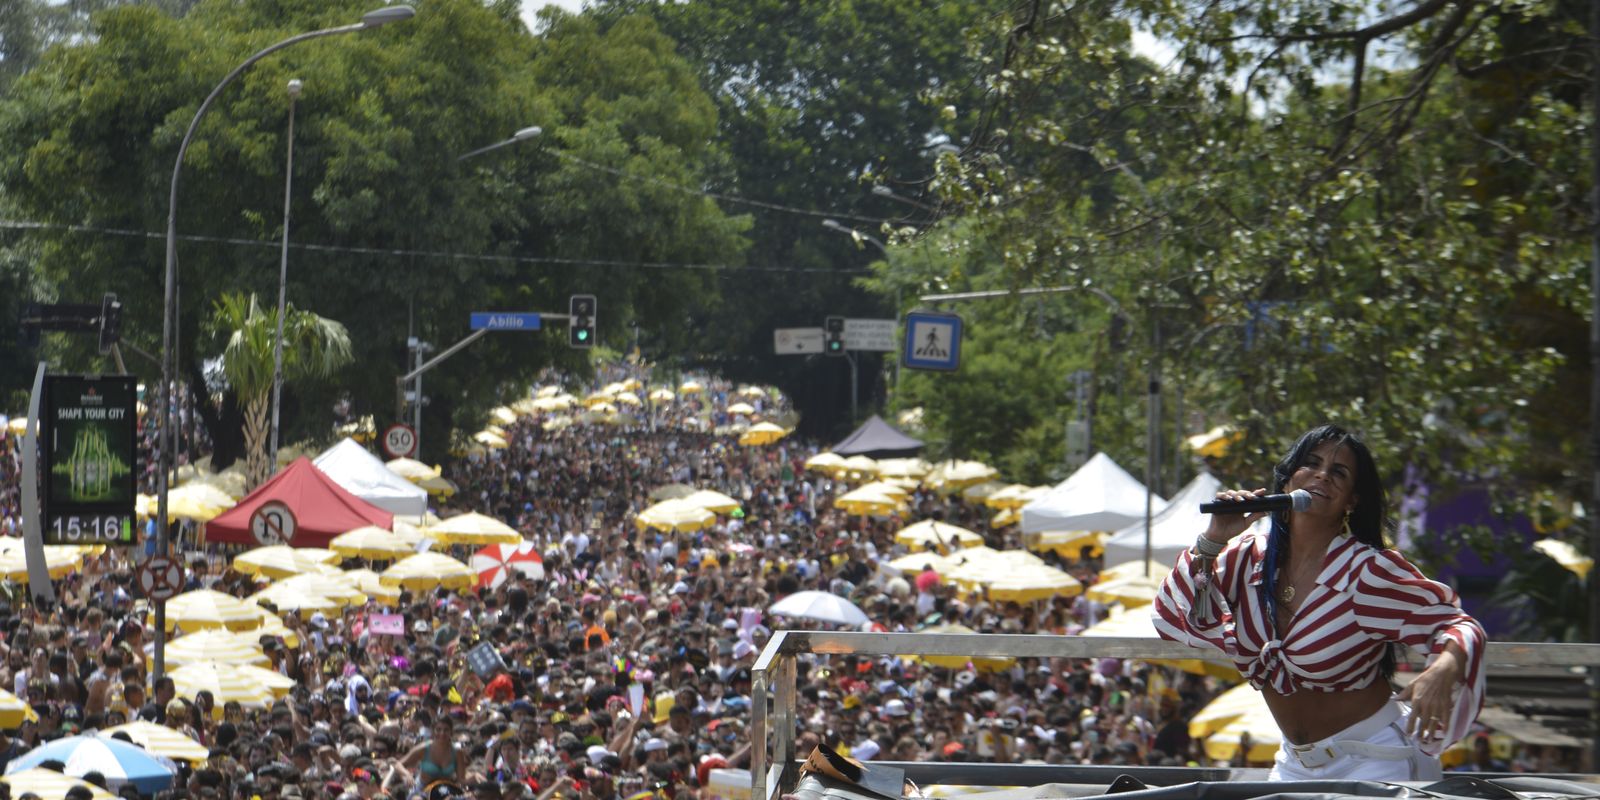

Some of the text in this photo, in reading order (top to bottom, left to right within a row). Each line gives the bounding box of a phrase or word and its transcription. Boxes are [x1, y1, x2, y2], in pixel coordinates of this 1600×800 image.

[58, 407, 125, 420] SHAPE YOUR CITY
[389, 431, 411, 447] 50
[53, 516, 118, 540] 15:16
